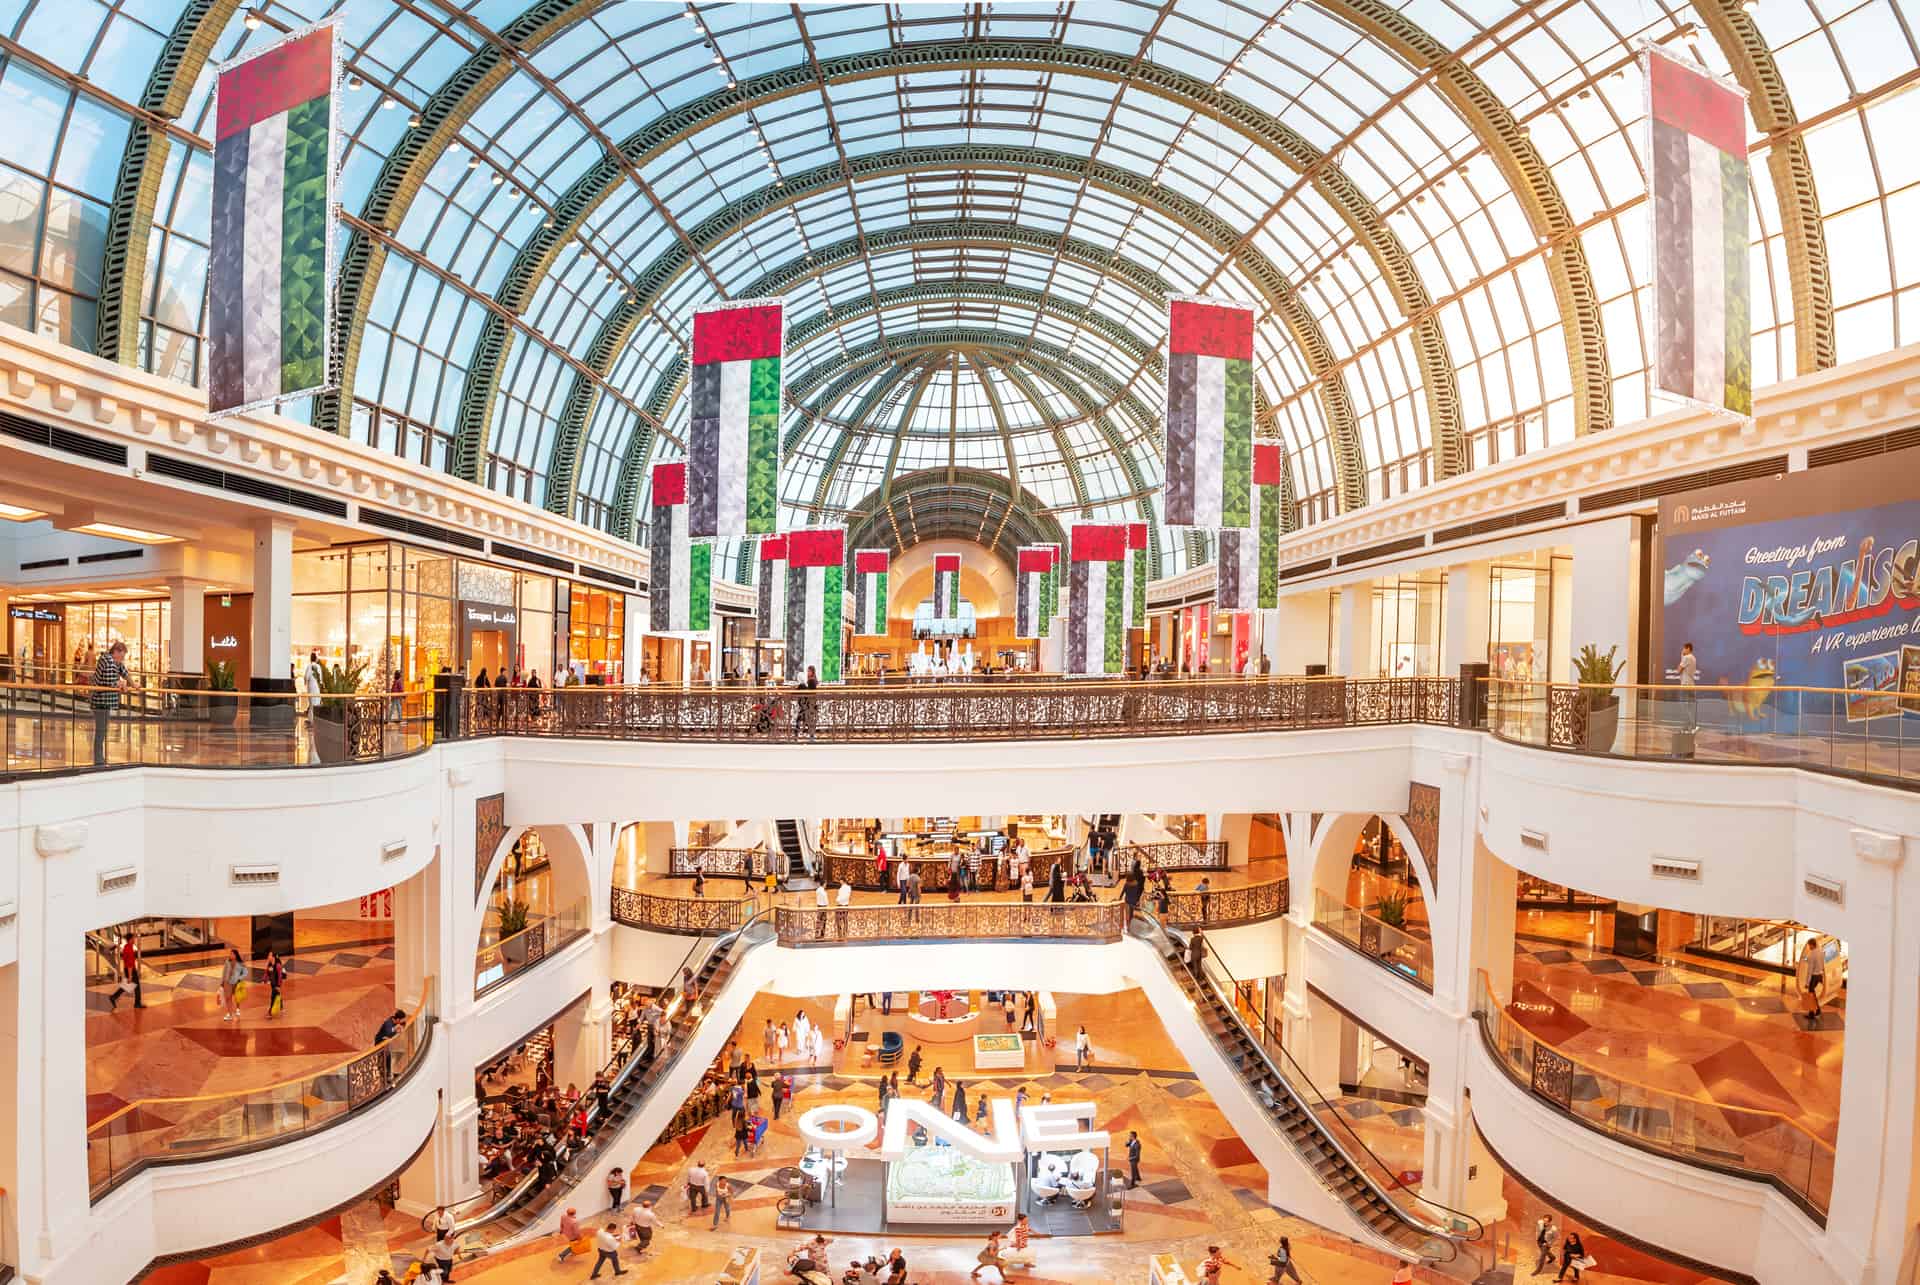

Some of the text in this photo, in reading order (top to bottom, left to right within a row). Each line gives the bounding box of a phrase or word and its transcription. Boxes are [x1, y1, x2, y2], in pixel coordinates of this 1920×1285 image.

[1745, 535, 1847, 569] Greetings from
[1738, 540, 1920, 626] DREAMSC
[1811, 635, 1824, 654] A
[1825, 631, 1845, 650] VR
[1845, 622, 1909, 651] experience
[798, 1098, 1111, 1162] ONE
